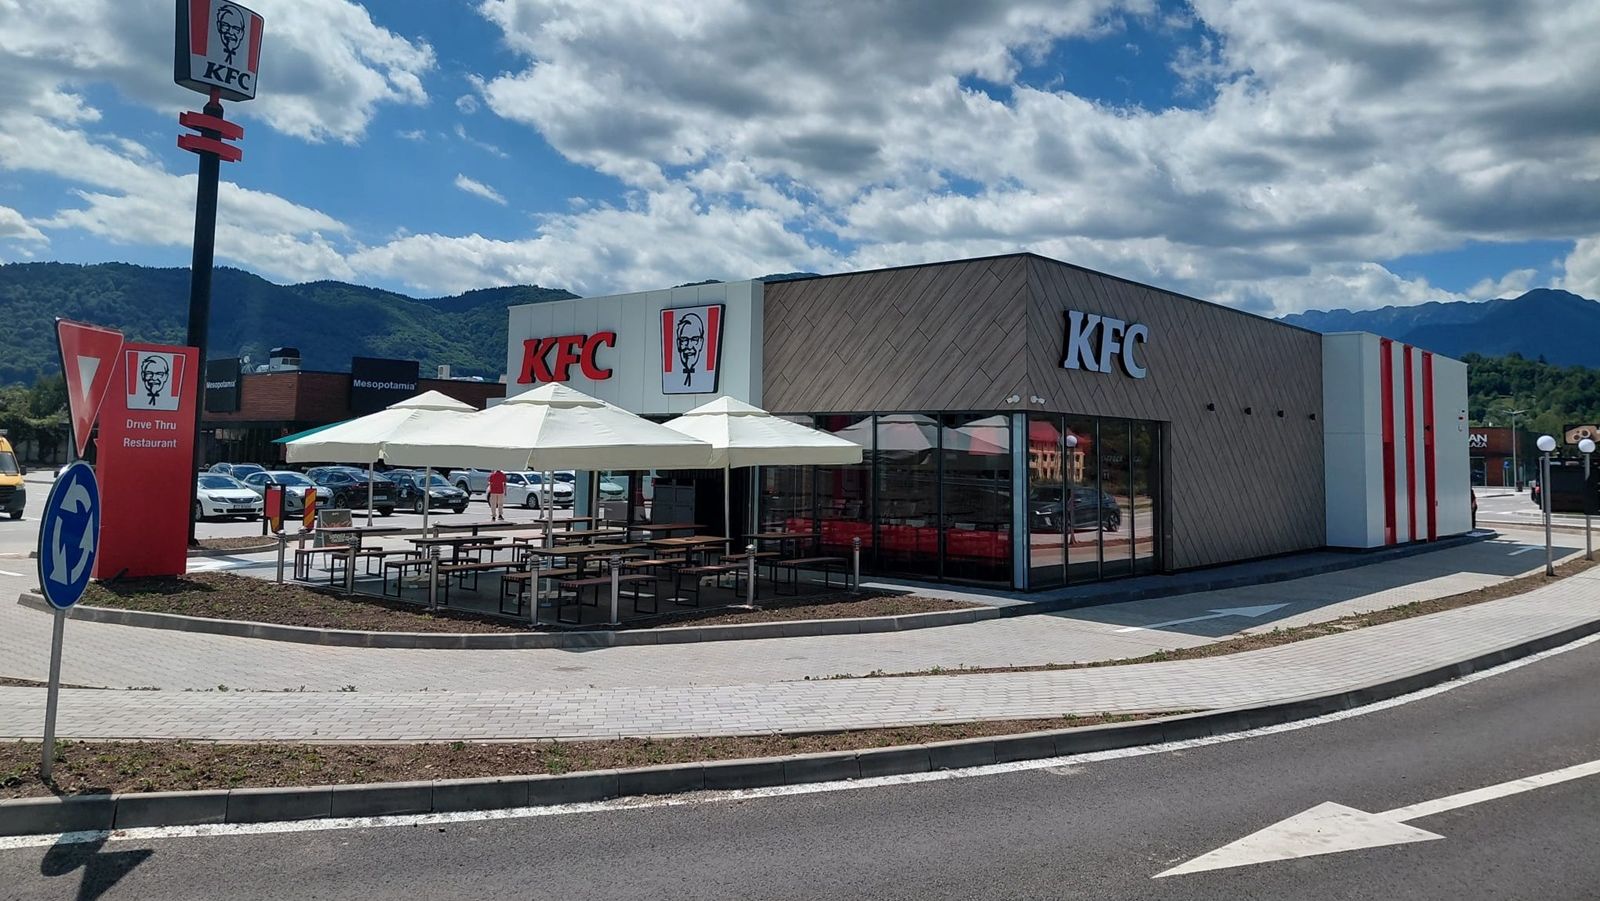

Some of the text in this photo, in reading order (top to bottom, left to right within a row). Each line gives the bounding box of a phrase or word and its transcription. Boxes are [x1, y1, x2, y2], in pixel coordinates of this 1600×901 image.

[203, 61, 251, 90] KFC
[1061, 310, 1148, 379] KFC
[517, 331, 617, 384] KFC
[353, 379, 415, 390] Mesopotamia
[126, 419, 177, 430] Drive Thru
[123, 437, 177, 448] Restaurant
